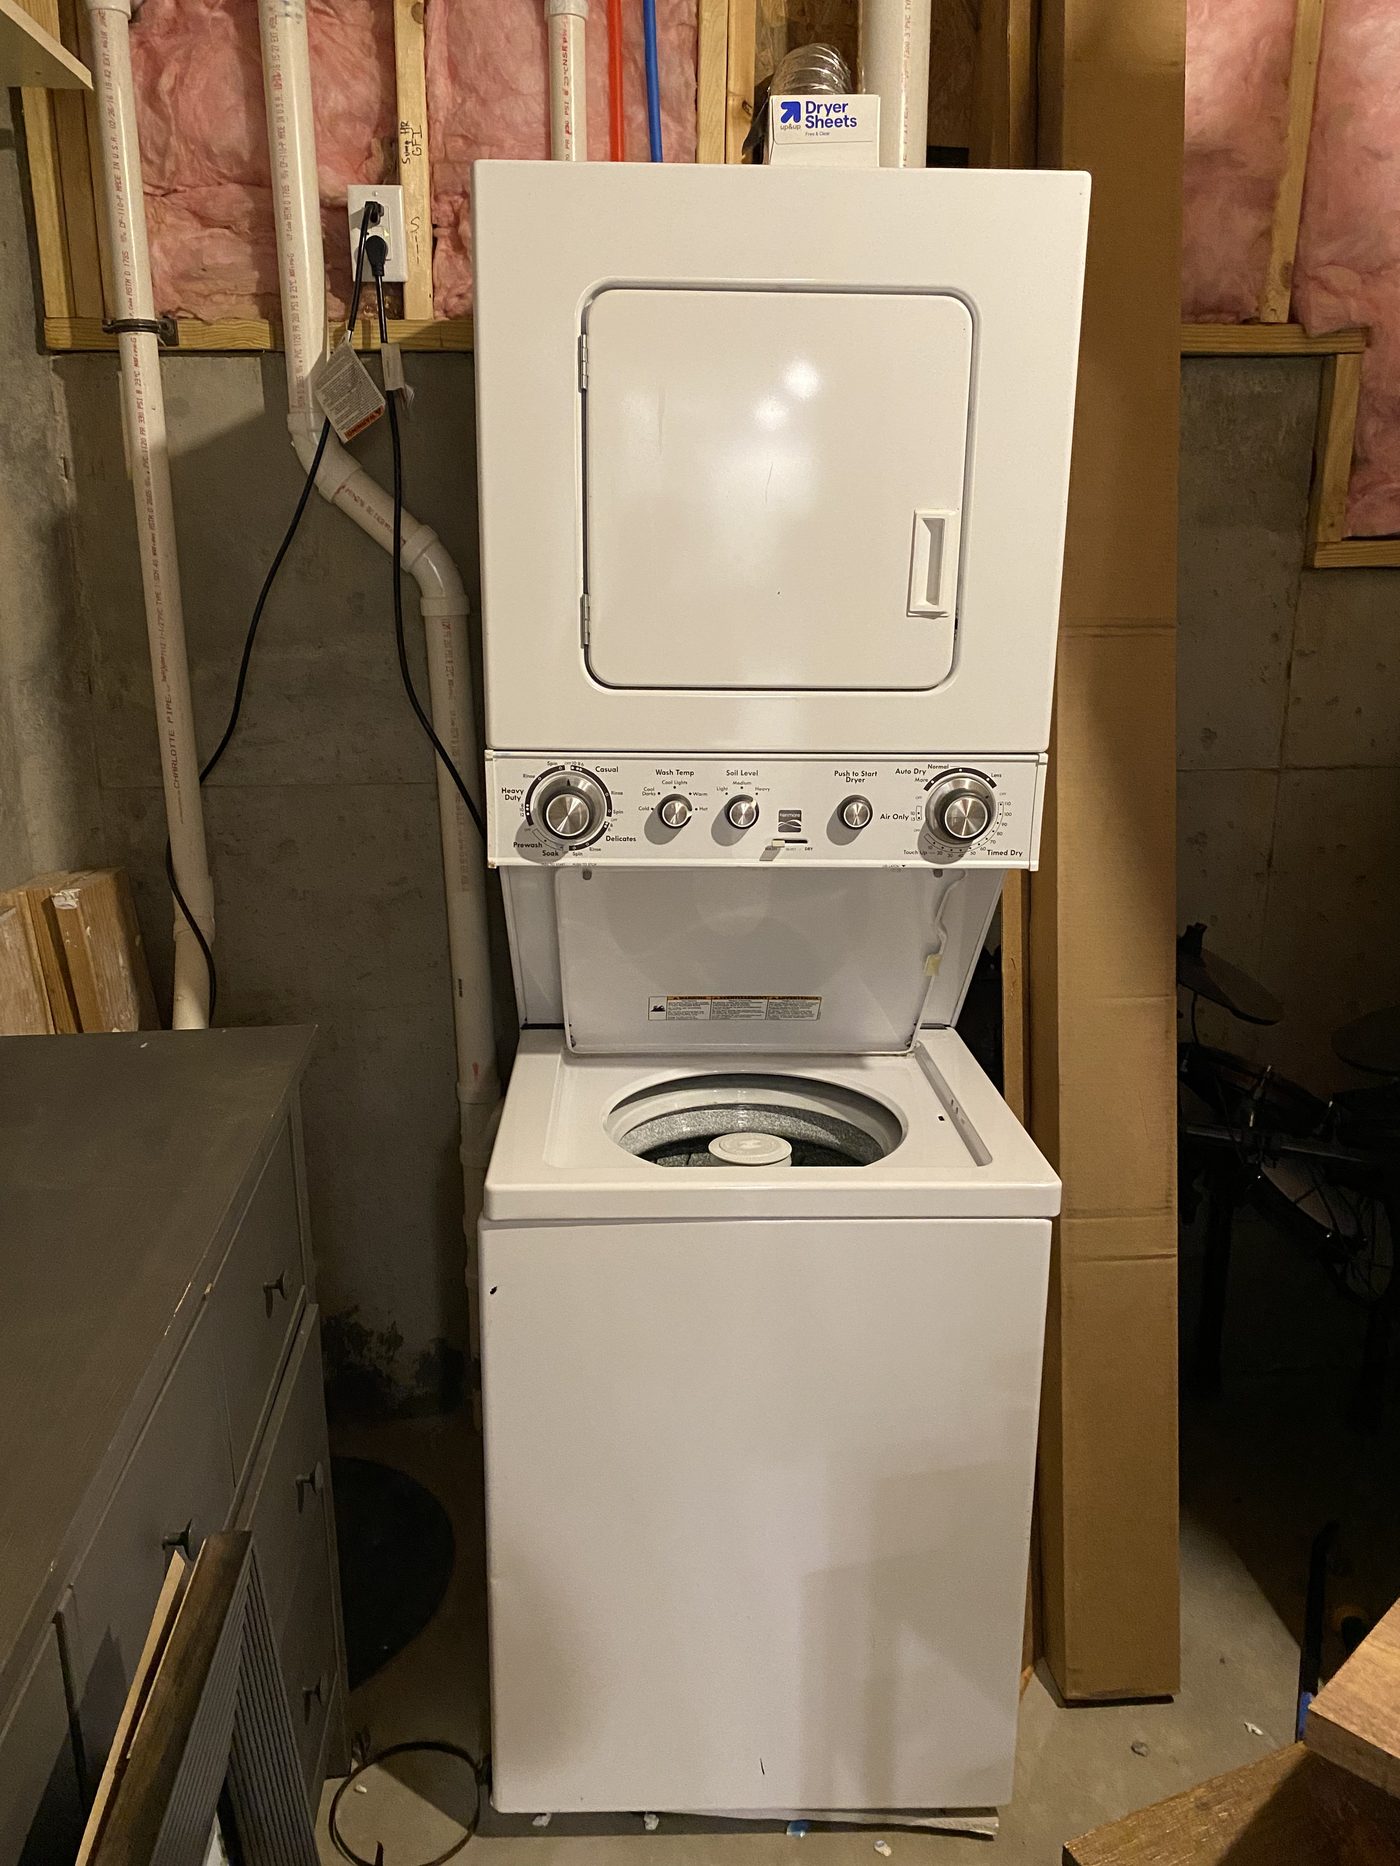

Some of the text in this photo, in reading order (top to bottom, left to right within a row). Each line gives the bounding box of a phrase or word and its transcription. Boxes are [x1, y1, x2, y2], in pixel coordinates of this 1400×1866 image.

[805, 100, 849, 117] Dryer
[805, 114, 858, 129] Sheets
[780, 123, 801, 131] up&up
[411, 124, 423, 157] GFI
[112, 161, 120, 171] IN
[124, 278, 133, 297] ASTM
[164, 696, 174, 724] PIPE
[167, 729, 180, 790] CHARLOTTE
[595, 765, 619, 773] Casual
[675, 769, 695, 777] Temp
[726, 769, 759, 777] Soil Level
[913, 768, 927, 776] Dry
[845, 776, 866, 785] Dryer
[501, 787, 524, 795] Heavy
[504, 794, 521, 802] Duty
[892, 813, 910, 821] Only
[986, 849, 1023, 857] Timed Dry
